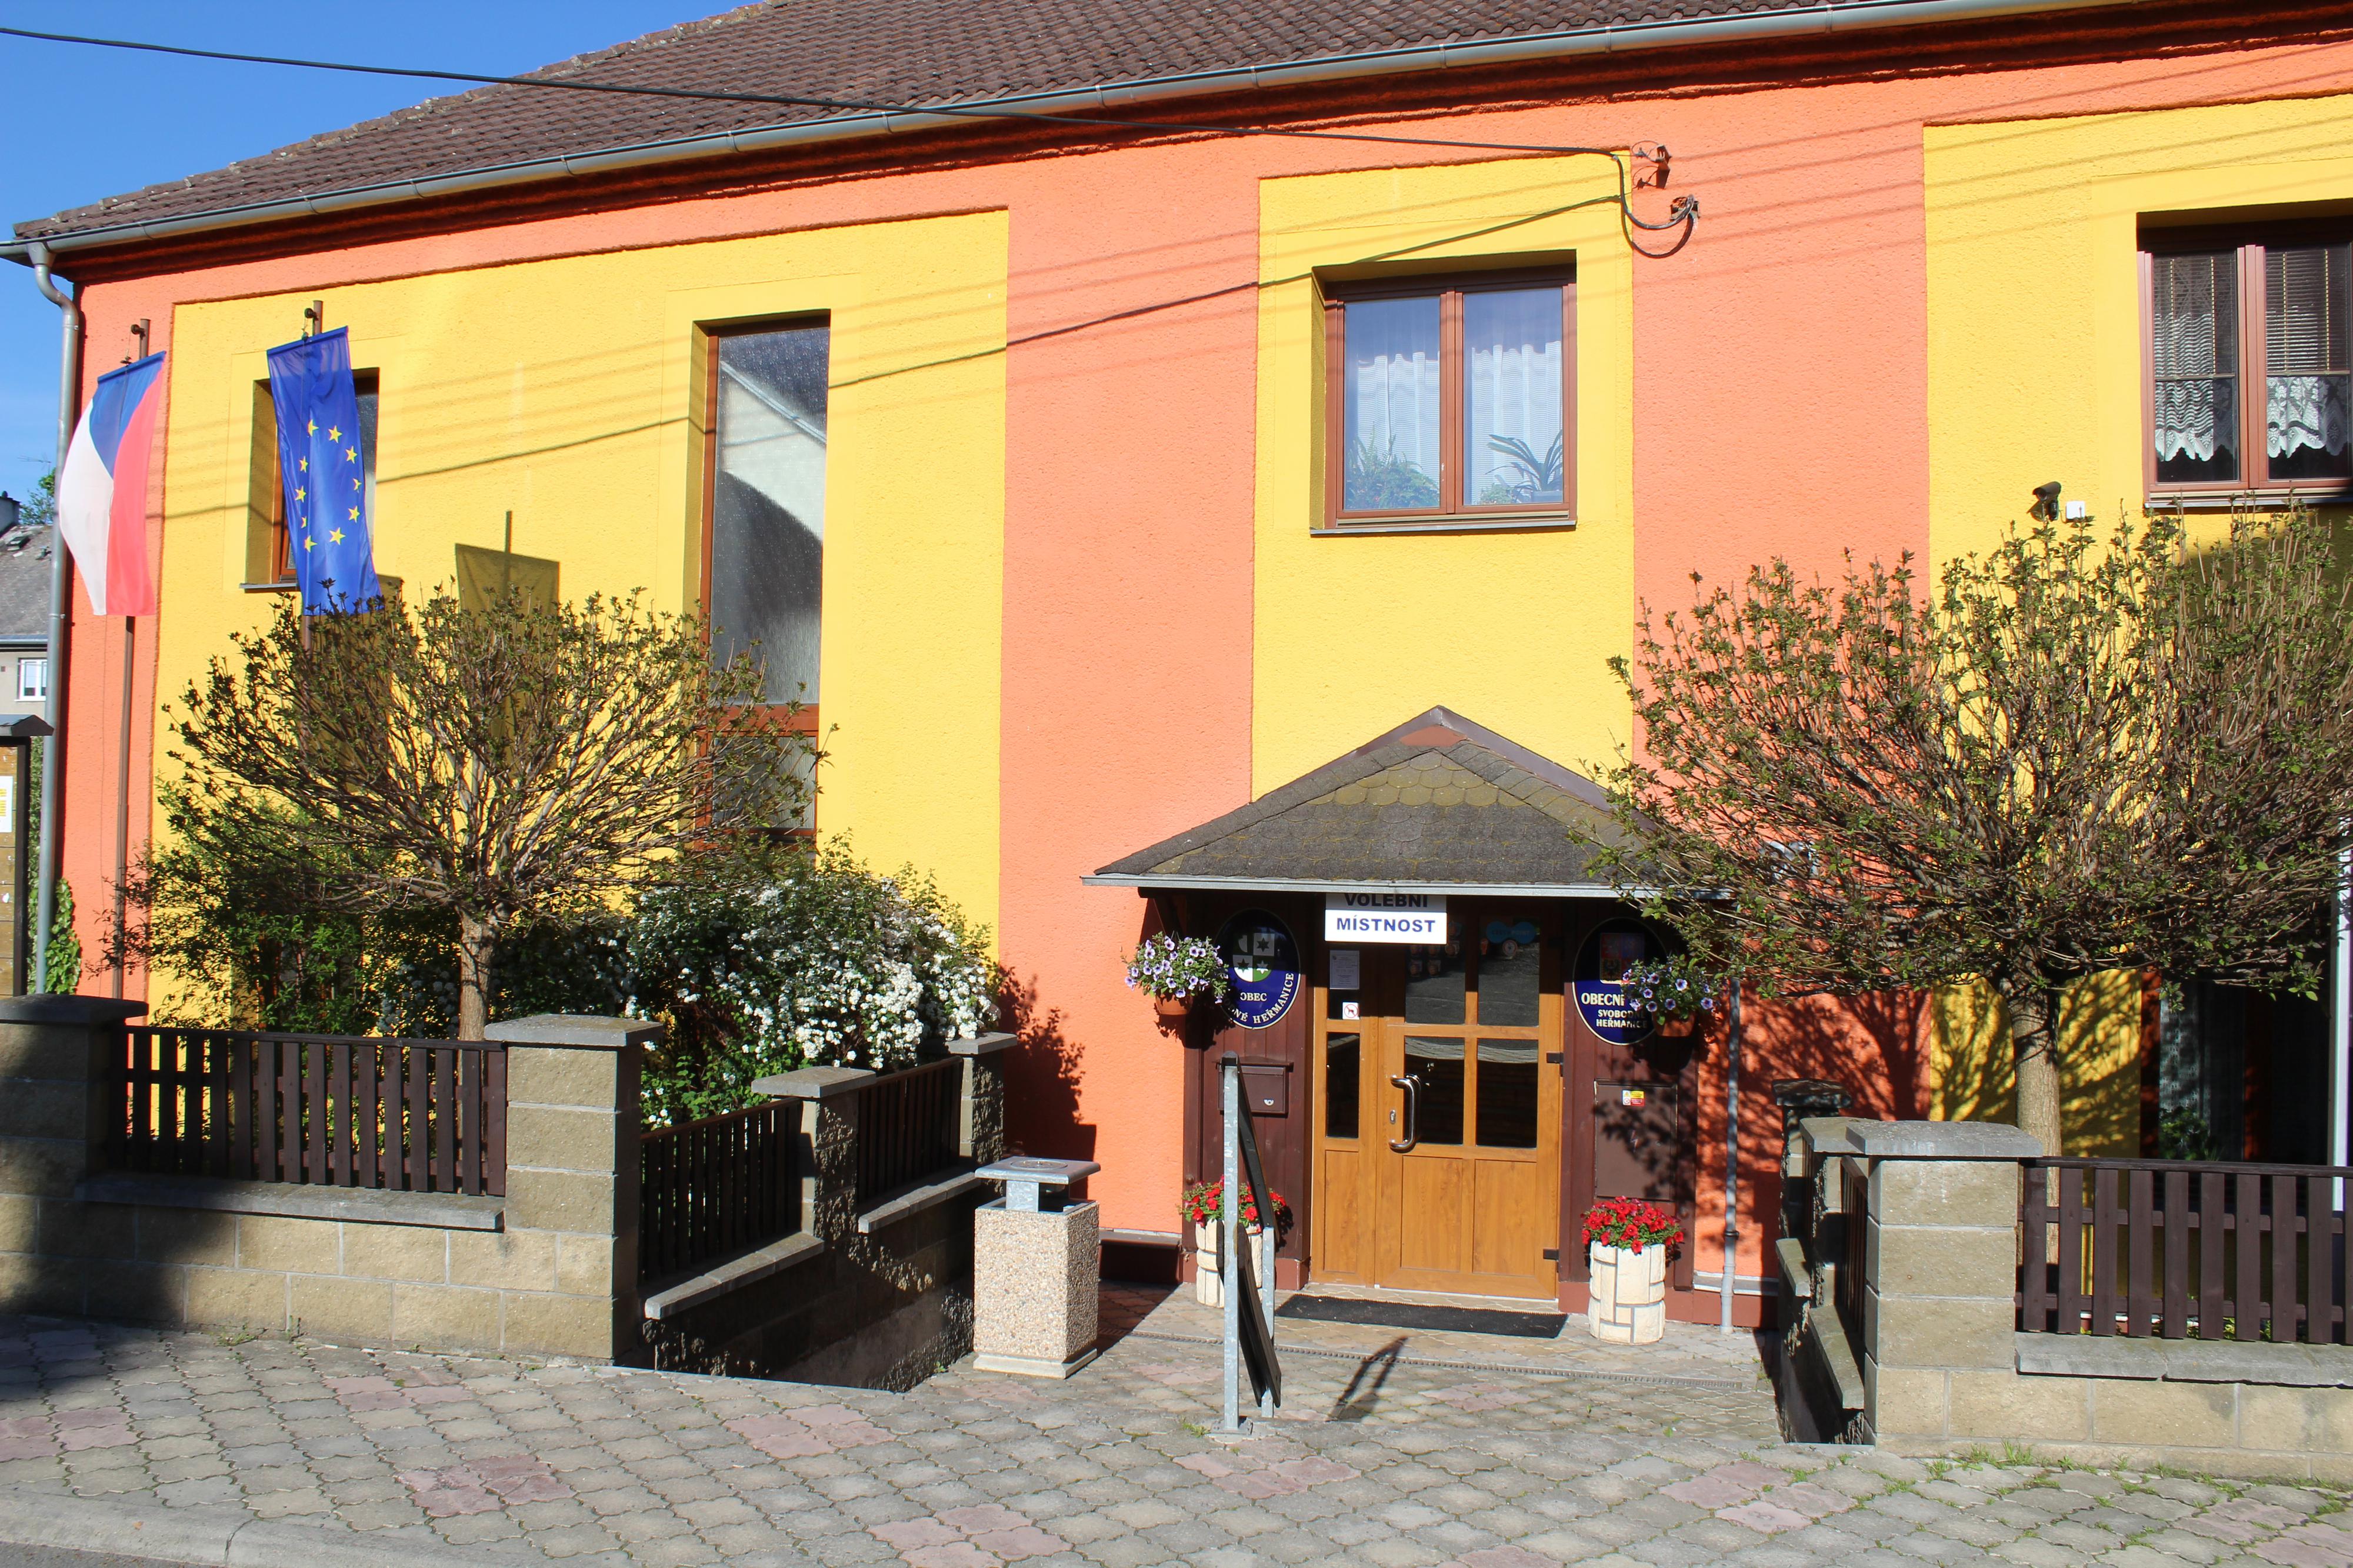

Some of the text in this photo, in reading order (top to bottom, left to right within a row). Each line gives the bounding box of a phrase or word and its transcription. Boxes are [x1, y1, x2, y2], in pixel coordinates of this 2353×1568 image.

[1337, 915, 1435, 932] MÍSTNOST
[1239, 992, 1267, 1002] OBEC
[1252, 973, 1294, 1024] HEŘMANICE
